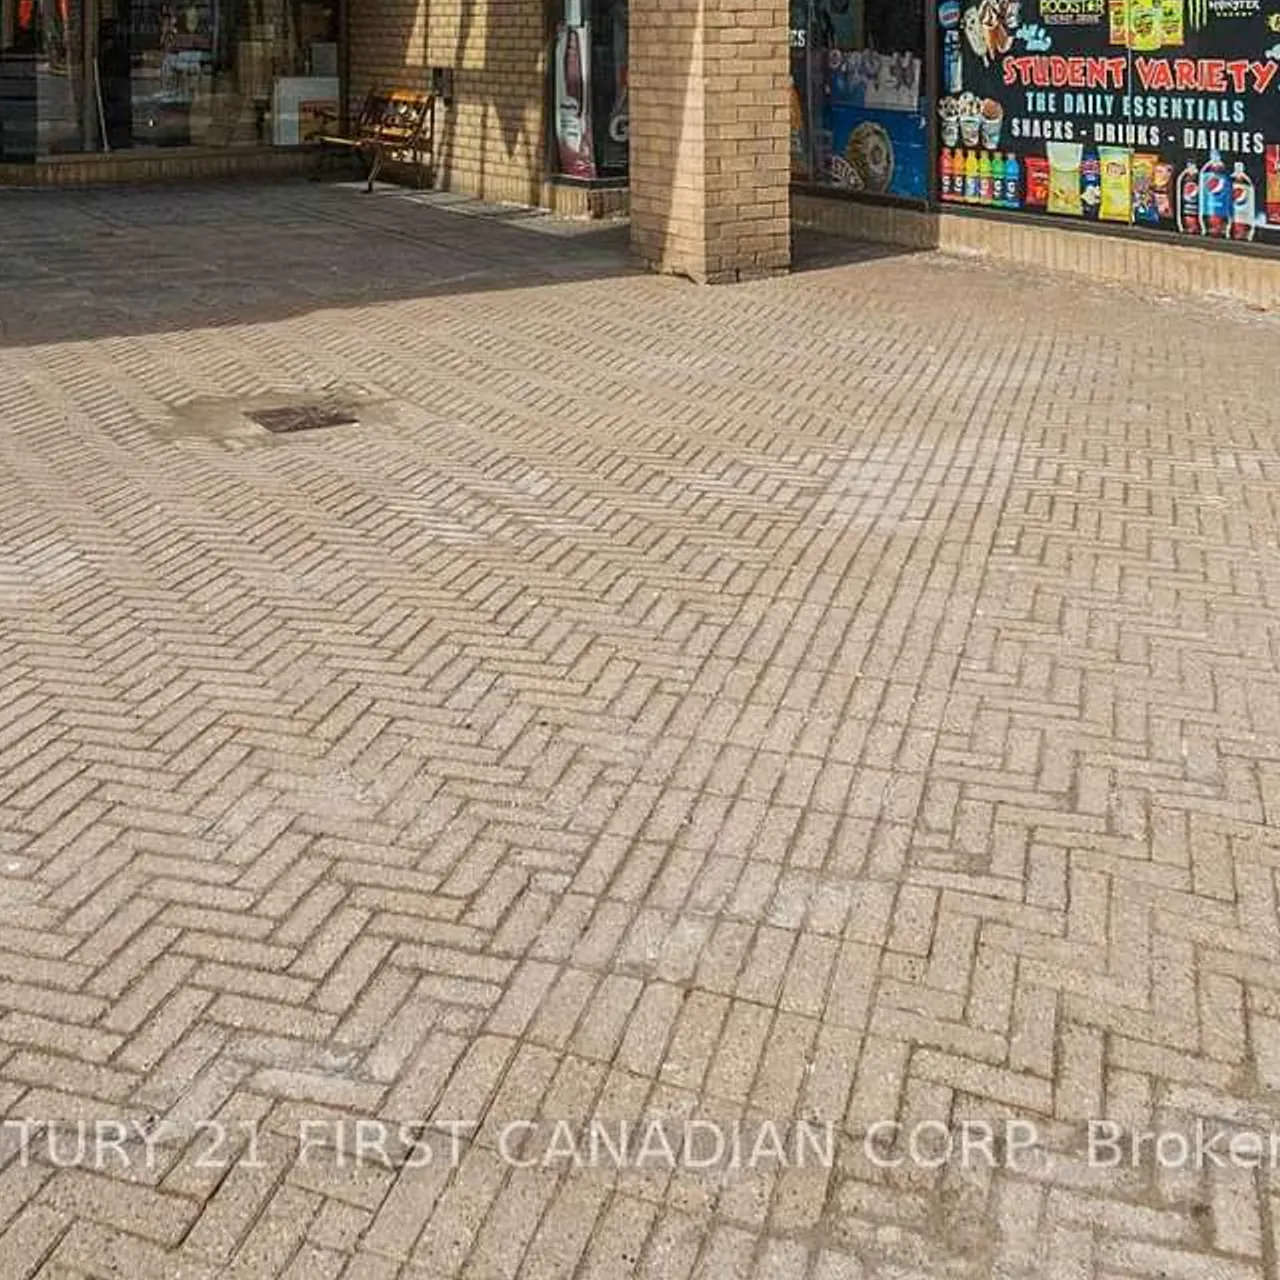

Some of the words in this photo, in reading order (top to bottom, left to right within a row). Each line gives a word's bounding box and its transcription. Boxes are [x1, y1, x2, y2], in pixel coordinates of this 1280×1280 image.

[1002, 55, 1127, 89] STUDENT
[1134, 56, 1279, 94] VARIETY
[1025, 91, 1057, 113] THE
[1063, 92, 1114, 116] DAILY
[1122, 95, 1246, 123] ESSENTIALS
[1011, 117, 1074, 140] SNACKS
[1093, 122, 1161, 146] DRINKS
[1183, 127, 1265, 154] DAIRIES
